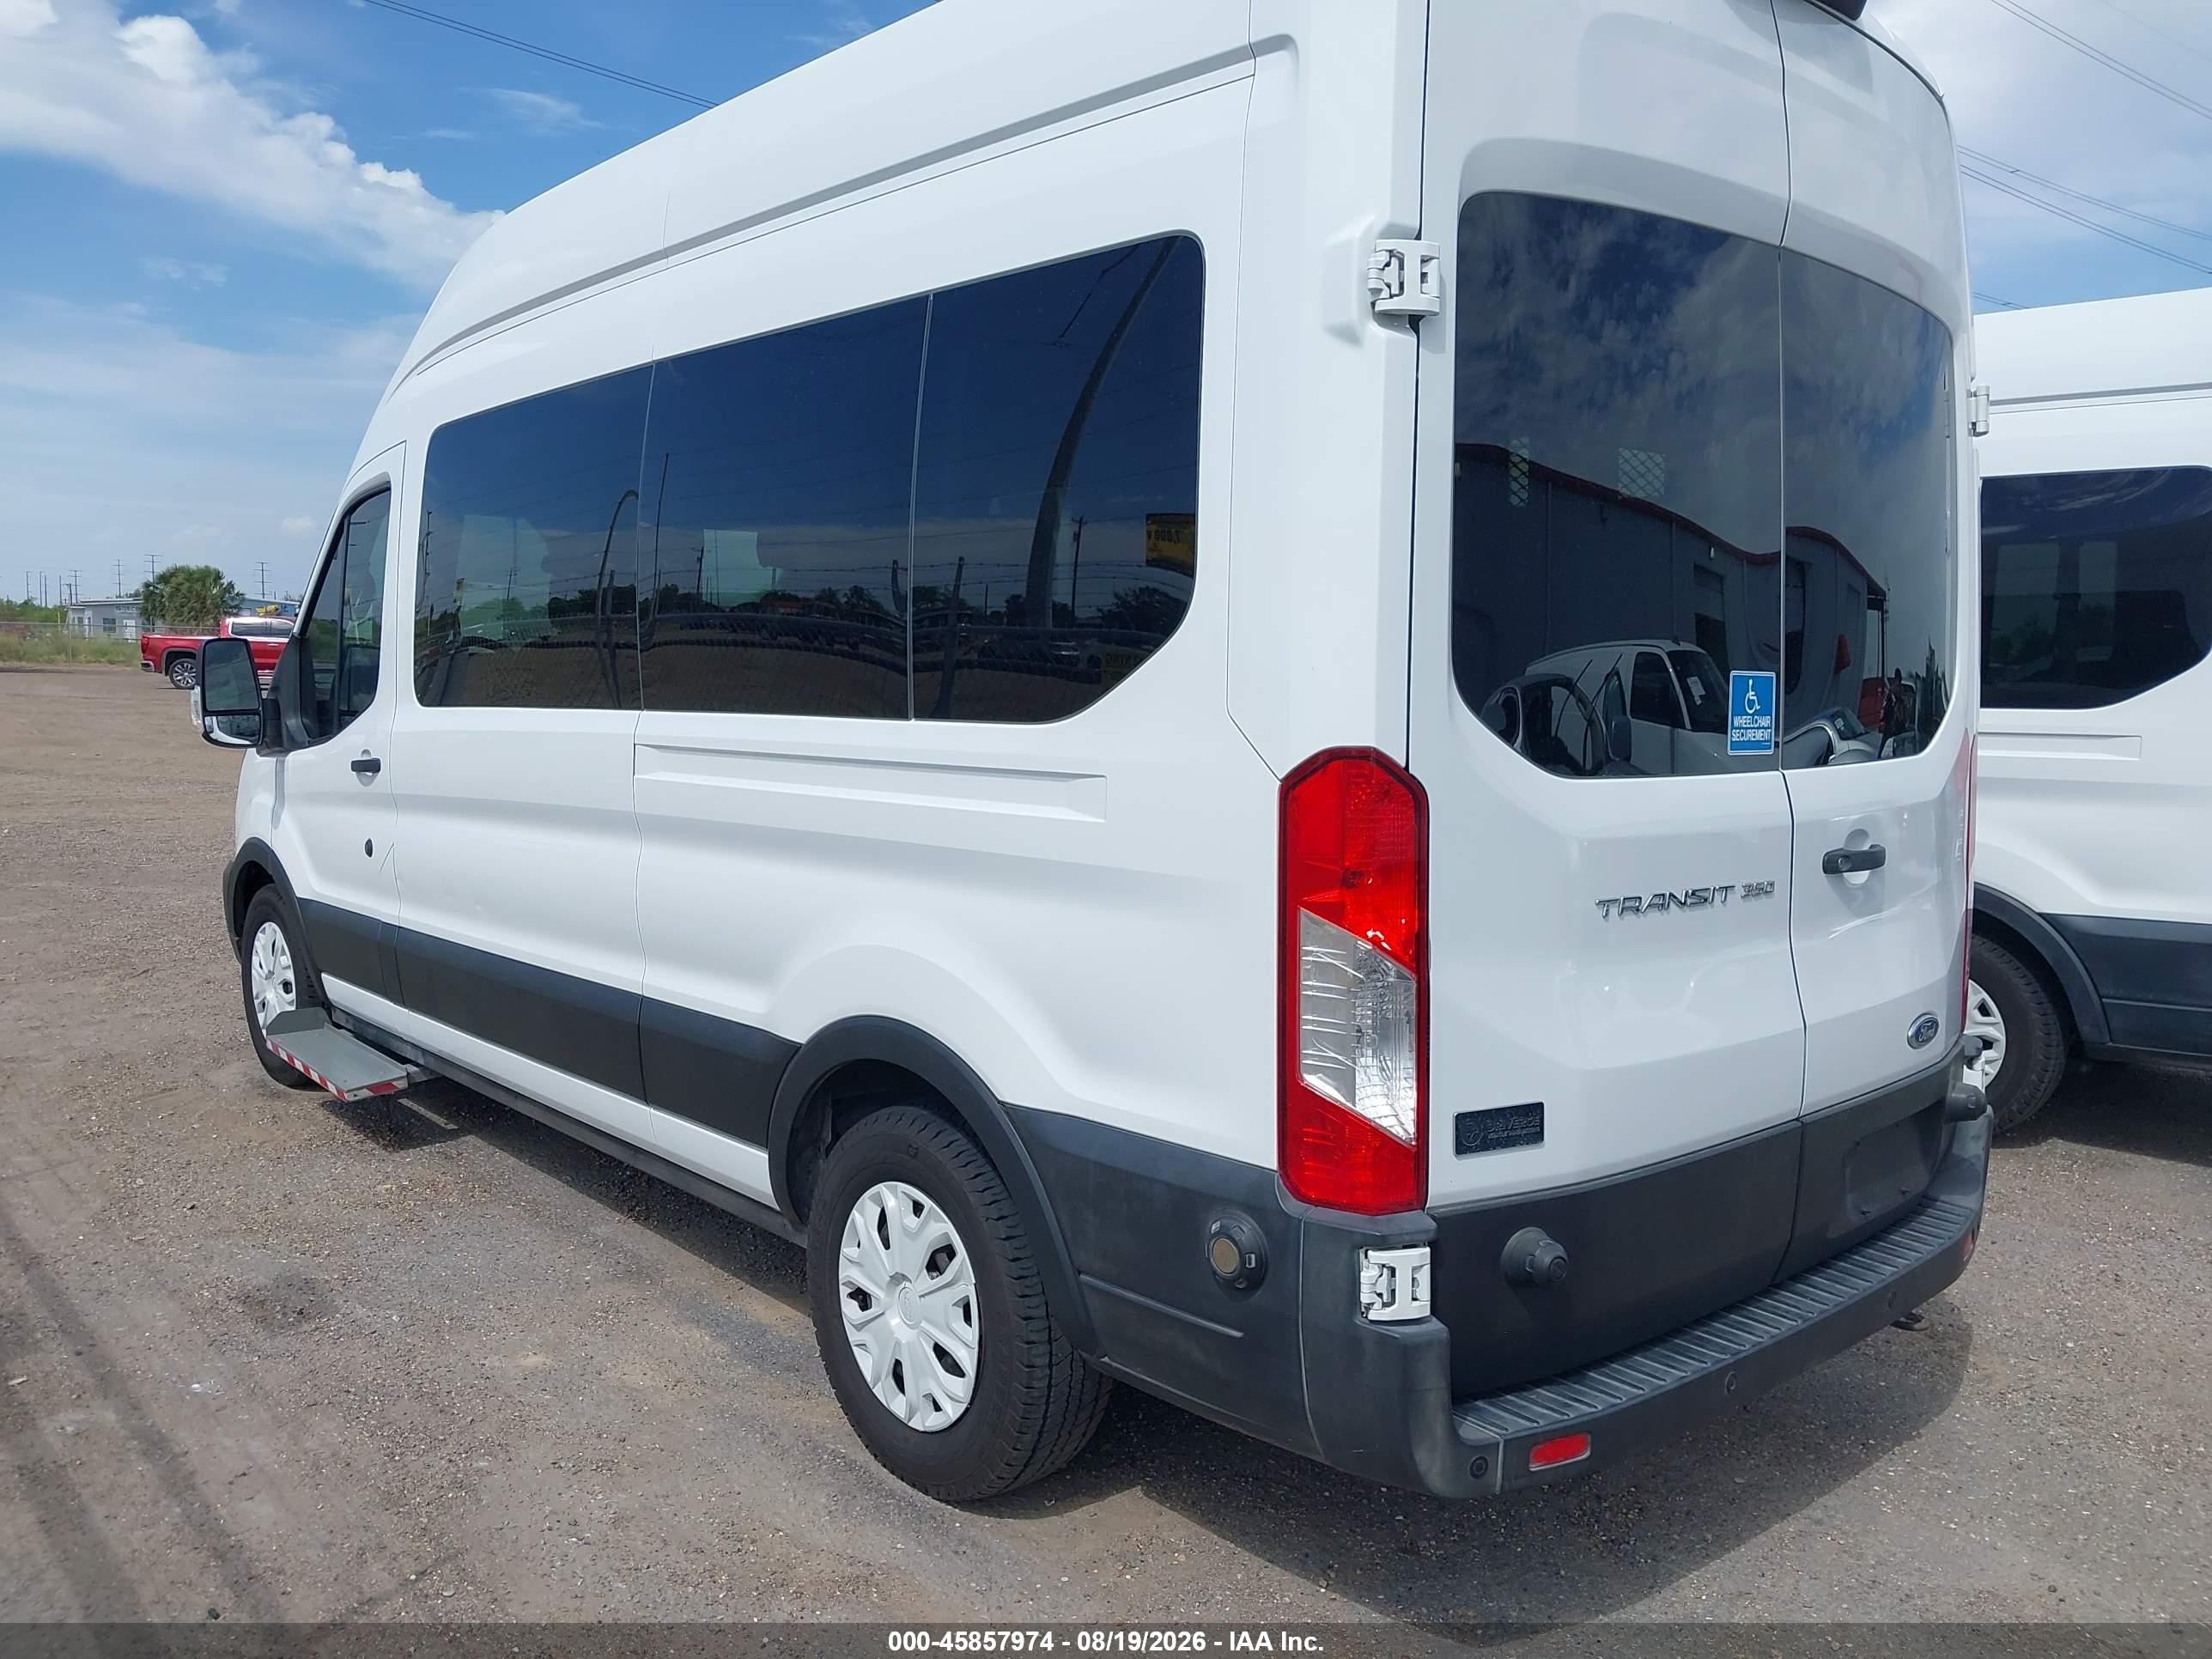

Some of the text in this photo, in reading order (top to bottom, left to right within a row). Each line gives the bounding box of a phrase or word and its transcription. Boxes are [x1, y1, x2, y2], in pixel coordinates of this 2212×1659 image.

[1733, 715, 1771, 728] WHEELCHAIR
[1731, 728, 1771, 742] SECUREMENT
[1595, 880, 1775, 918] TRANSIT 350
